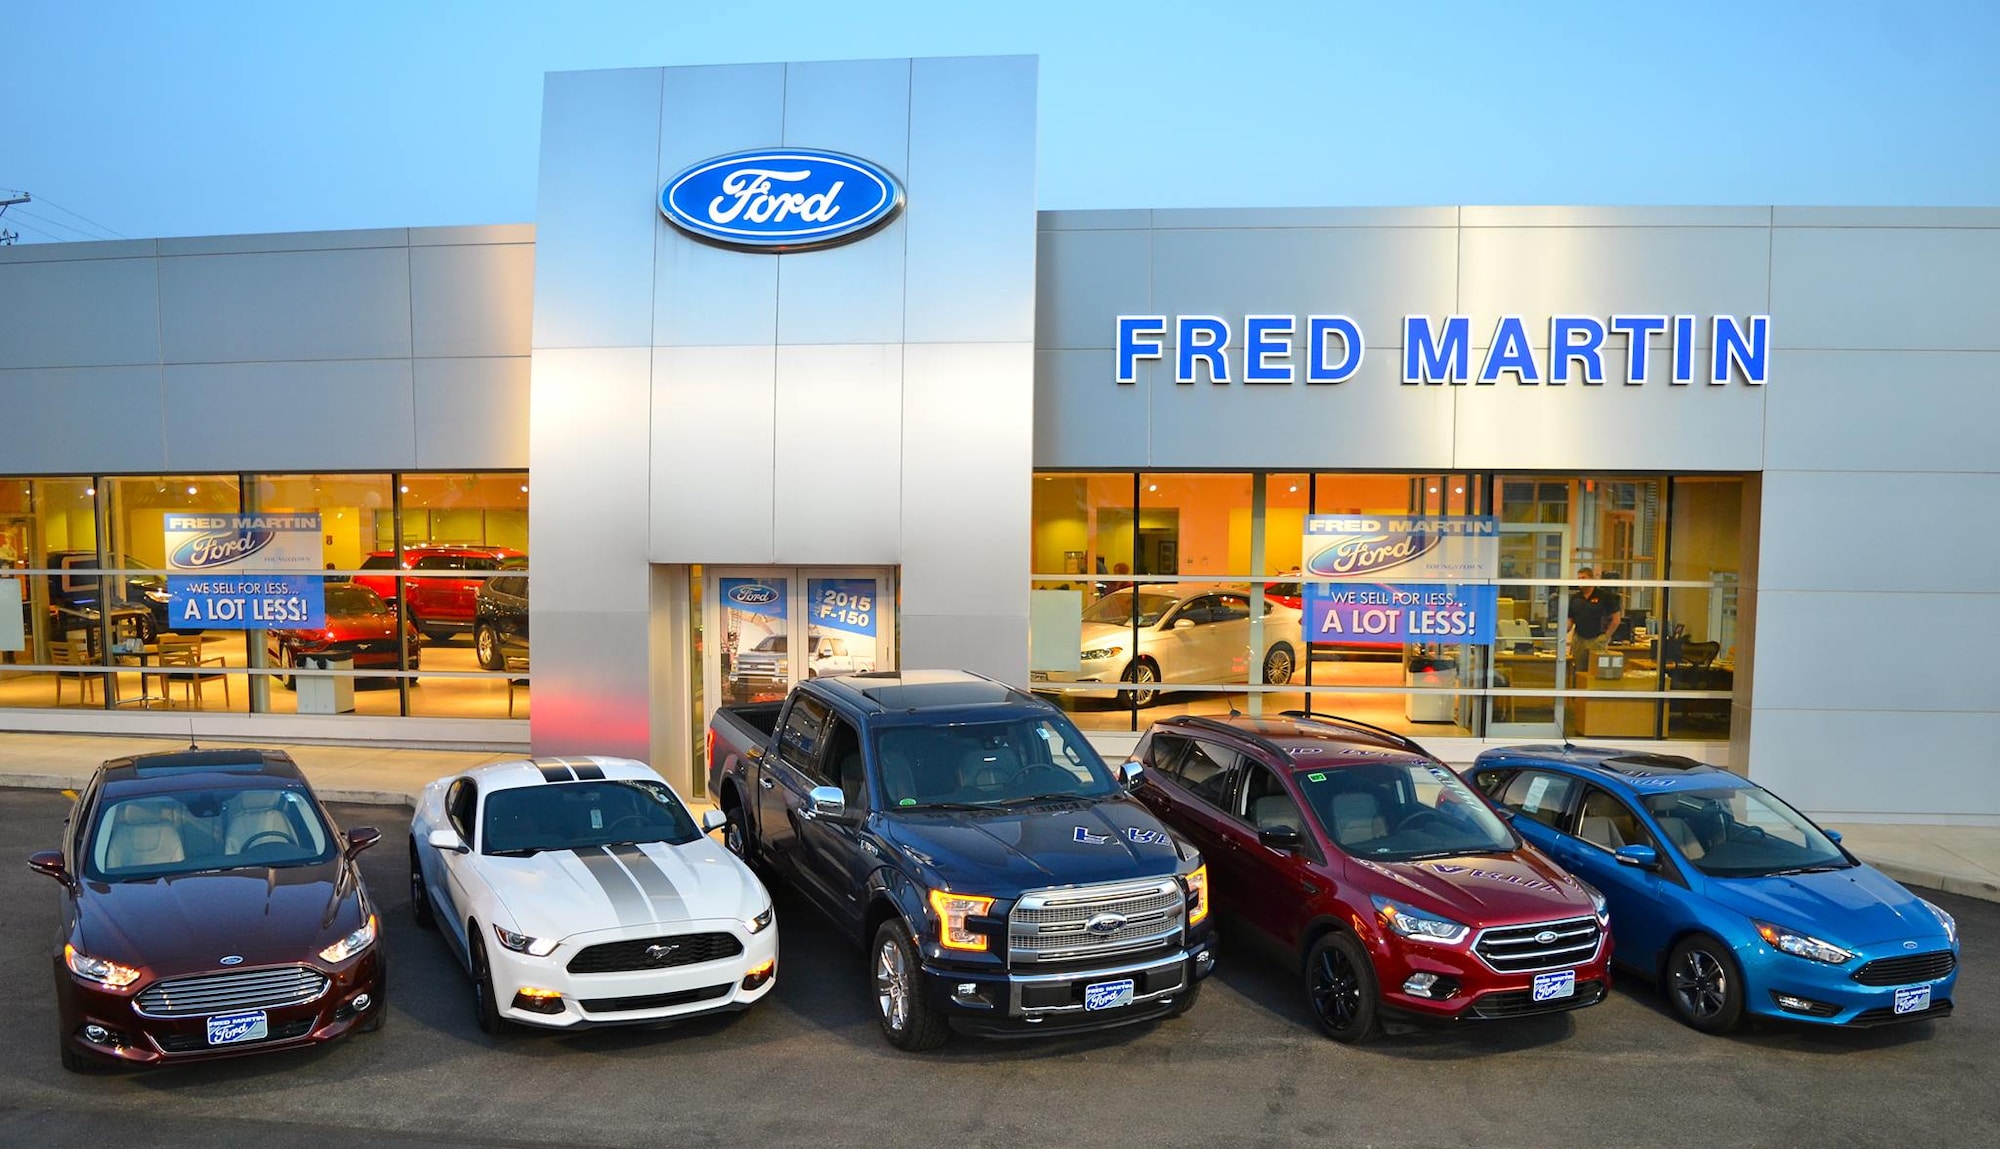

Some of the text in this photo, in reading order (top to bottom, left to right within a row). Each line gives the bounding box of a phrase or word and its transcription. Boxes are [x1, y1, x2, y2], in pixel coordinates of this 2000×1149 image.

[708, 168, 844, 224] Ford
[1116, 314, 1770, 385] FRED MARTIN
[169, 517, 316, 529] FRED MARTIN
[1309, 519, 1492, 533] FRED MARTIN
[190, 531, 256, 565] Ford
[1333, 535, 1416, 572] Ford
[189, 583, 213, 594] WE
[213, 583, 235, 595] SELL
[238, 583, 261, 595] FOR
[736, 587, 771, 602] Ford
[1331, 591, 1357, 605] WE
[1360, 591, 1388, 605] SELL
[1392, 591, 1420, 605] FOR
[184, 598, 308, 621] A LOT LESS!
[823, 589, 871, 612] 2015
[820, 604, 870, 627] F-150
[1321, 609, 1476, 636] A LOT LESS!
[1090, 990, 1118, 1008] Ford
[1537, 982, 1561, 999] Ford
[214, 1022, 248, 1043] Ford
